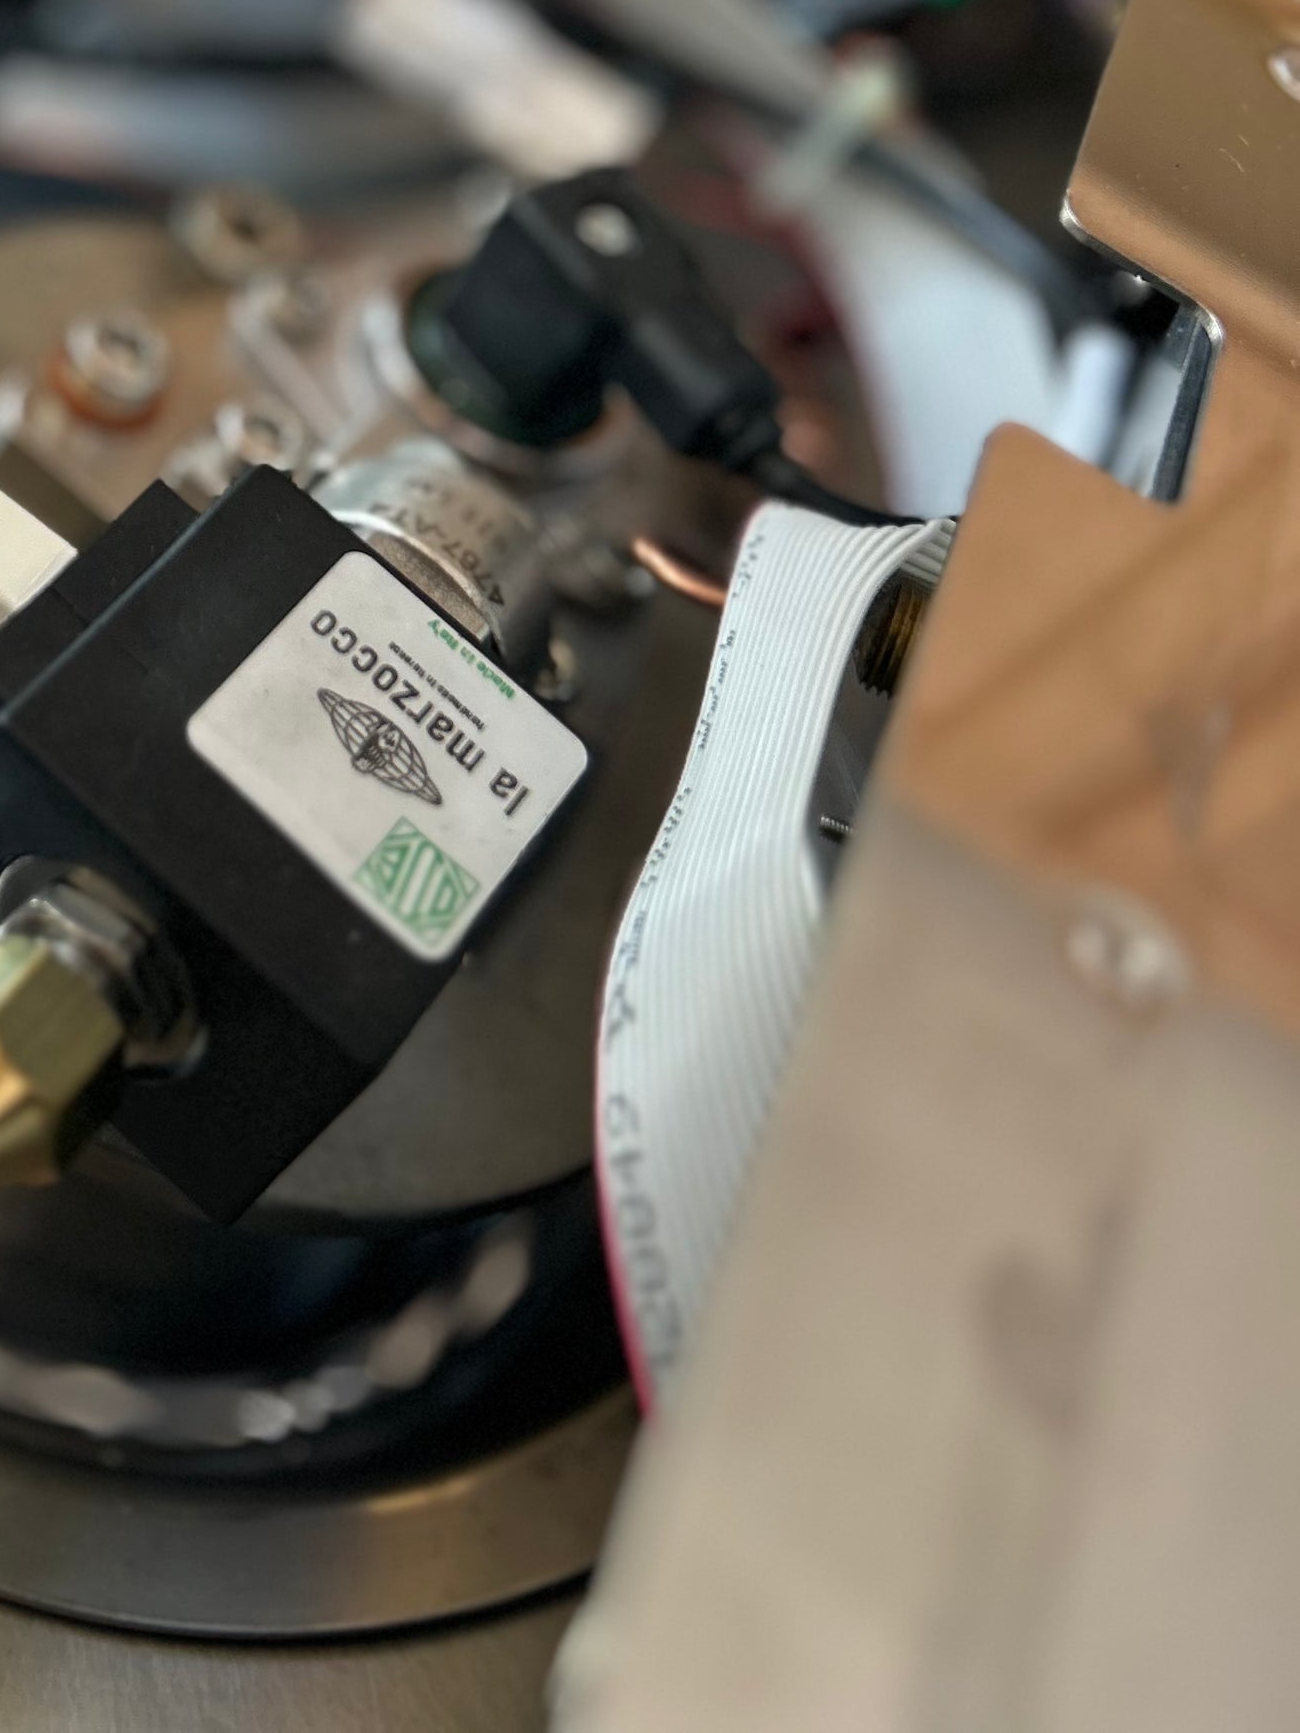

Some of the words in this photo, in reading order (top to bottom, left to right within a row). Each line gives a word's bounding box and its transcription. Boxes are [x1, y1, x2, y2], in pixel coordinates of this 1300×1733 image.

[459, 646, 476, 665] in
[310, 608, 486, 773] marzocco
[476, 661, 516, 699] Made
[488, 766, 530, 817] la
